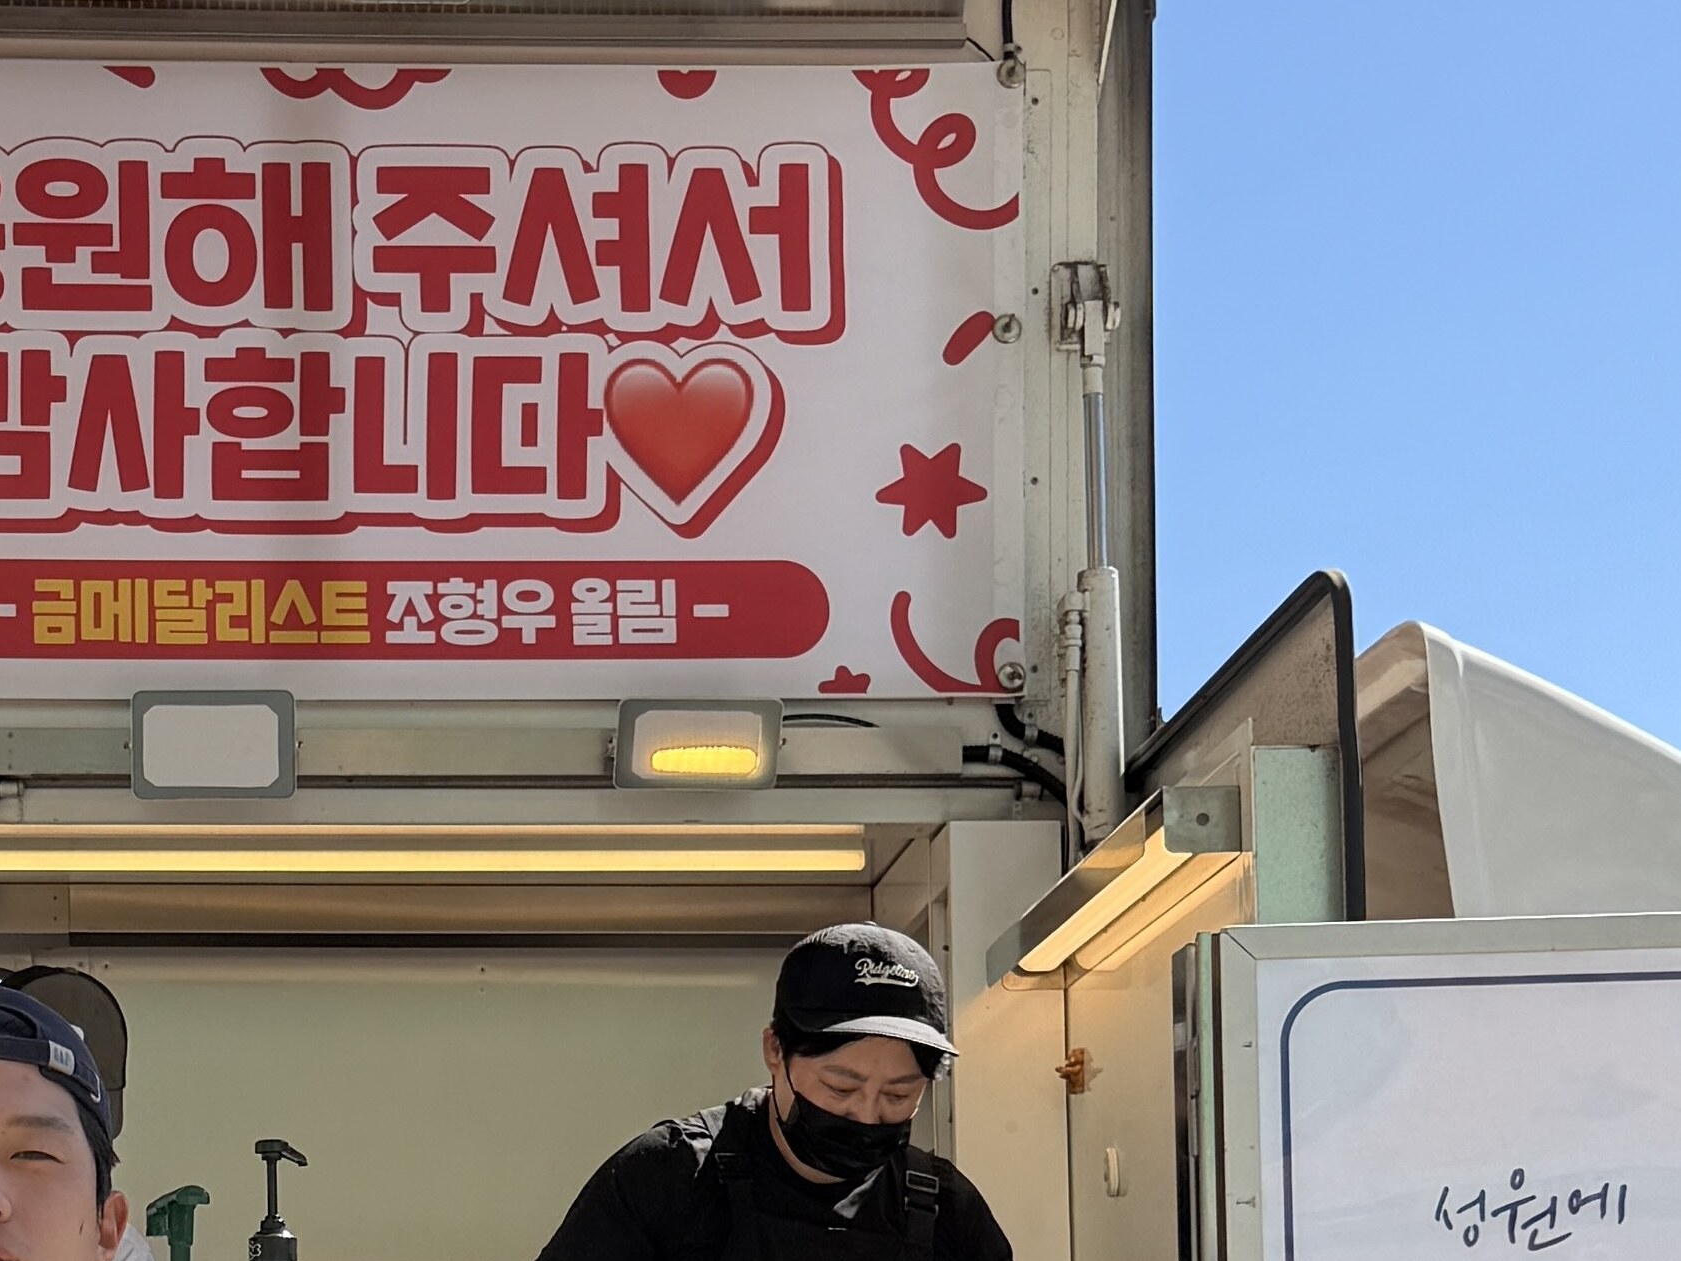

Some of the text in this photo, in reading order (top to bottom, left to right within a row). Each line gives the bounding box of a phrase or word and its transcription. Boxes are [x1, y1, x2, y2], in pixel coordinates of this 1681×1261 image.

[372, 162, 812, 313] 주셔서
[31, 578, 371, 645] 금메달리스트
[385, 577, 556, 646] 조형우
[570, 577, 677, 645] 올림
[1435, 1167, 1628, 1251] 성원에
